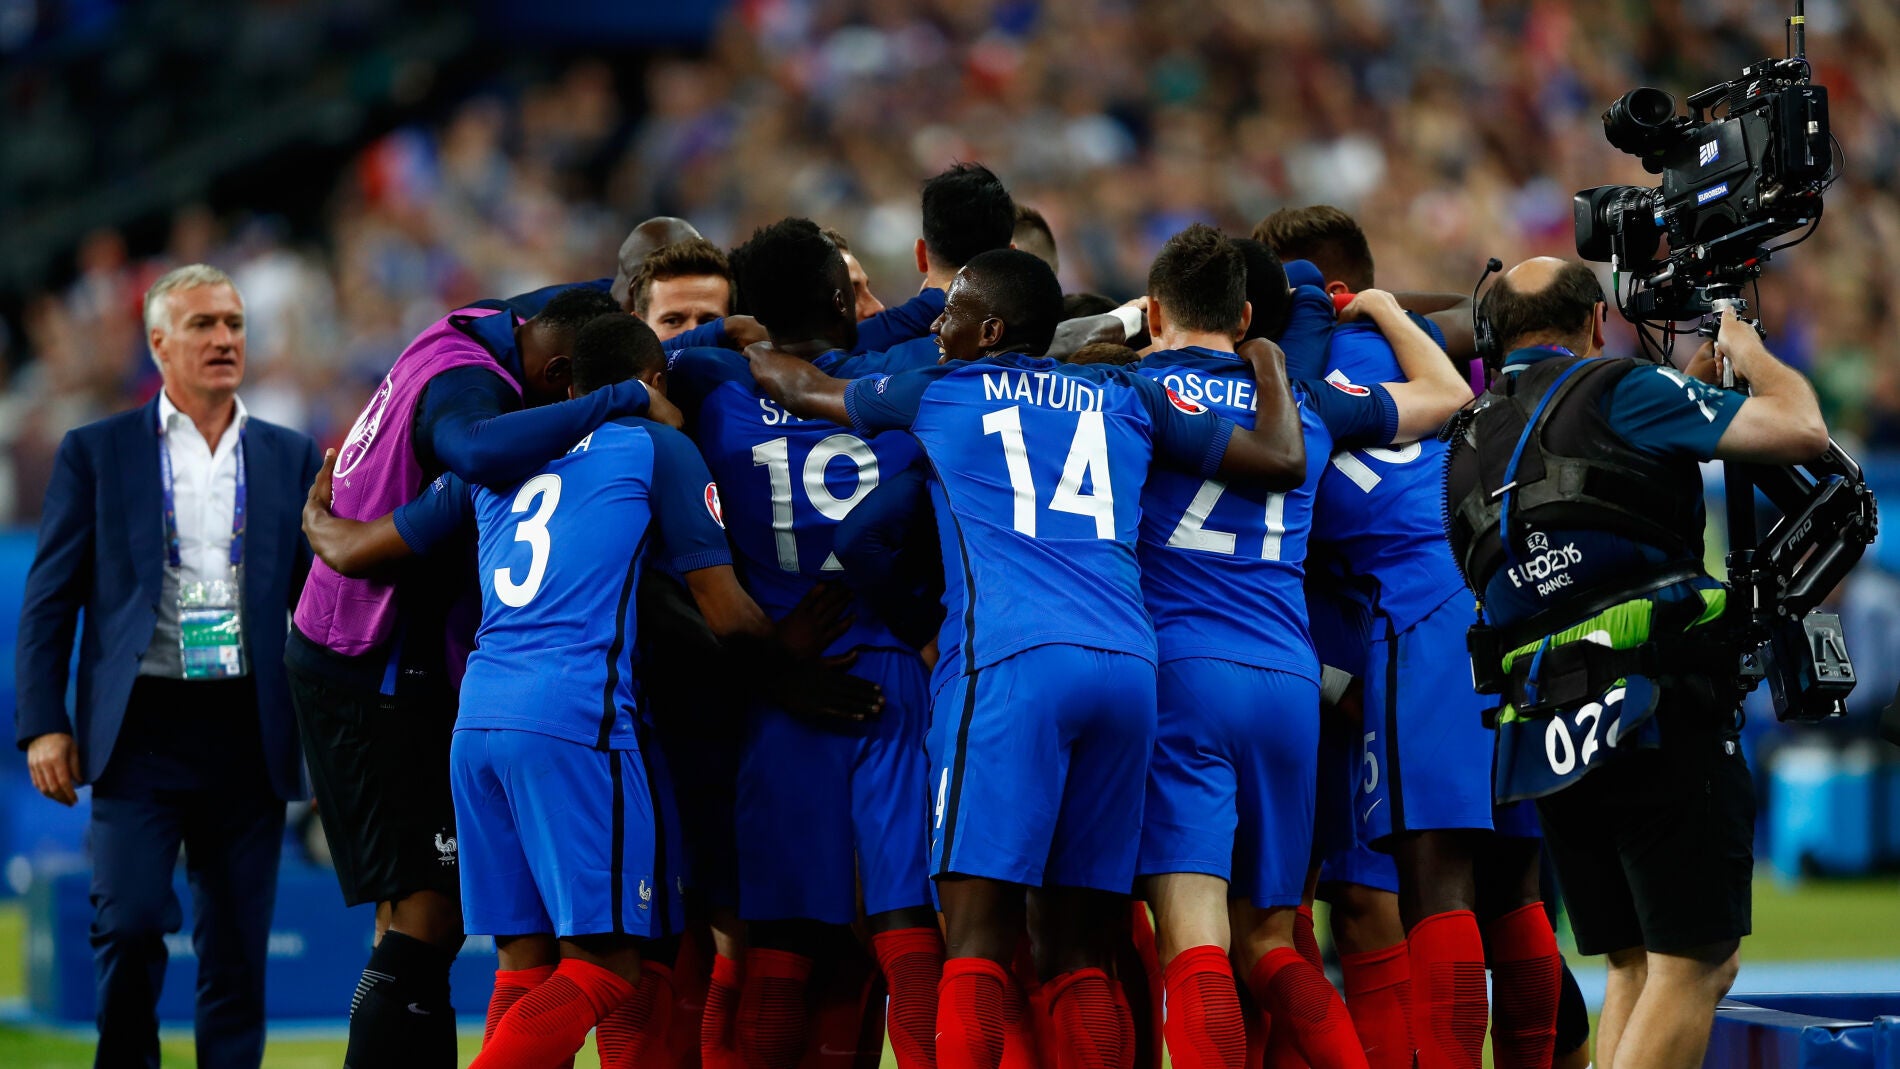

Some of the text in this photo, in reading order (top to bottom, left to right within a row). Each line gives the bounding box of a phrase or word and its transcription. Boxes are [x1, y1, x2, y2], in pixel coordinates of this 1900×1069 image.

[1697, 185, 1727, 202] EUROMEDIA
[982, 370, 1104, 412] MATUIDI
[982, 405, 1116, 540] 14
[494, 473, 562, 608] 3
[1526, 535, 1548, 549] EFA
[1788, 518, 1812, 551] PRO
[1536, 572, 1574, 597] RANCE
